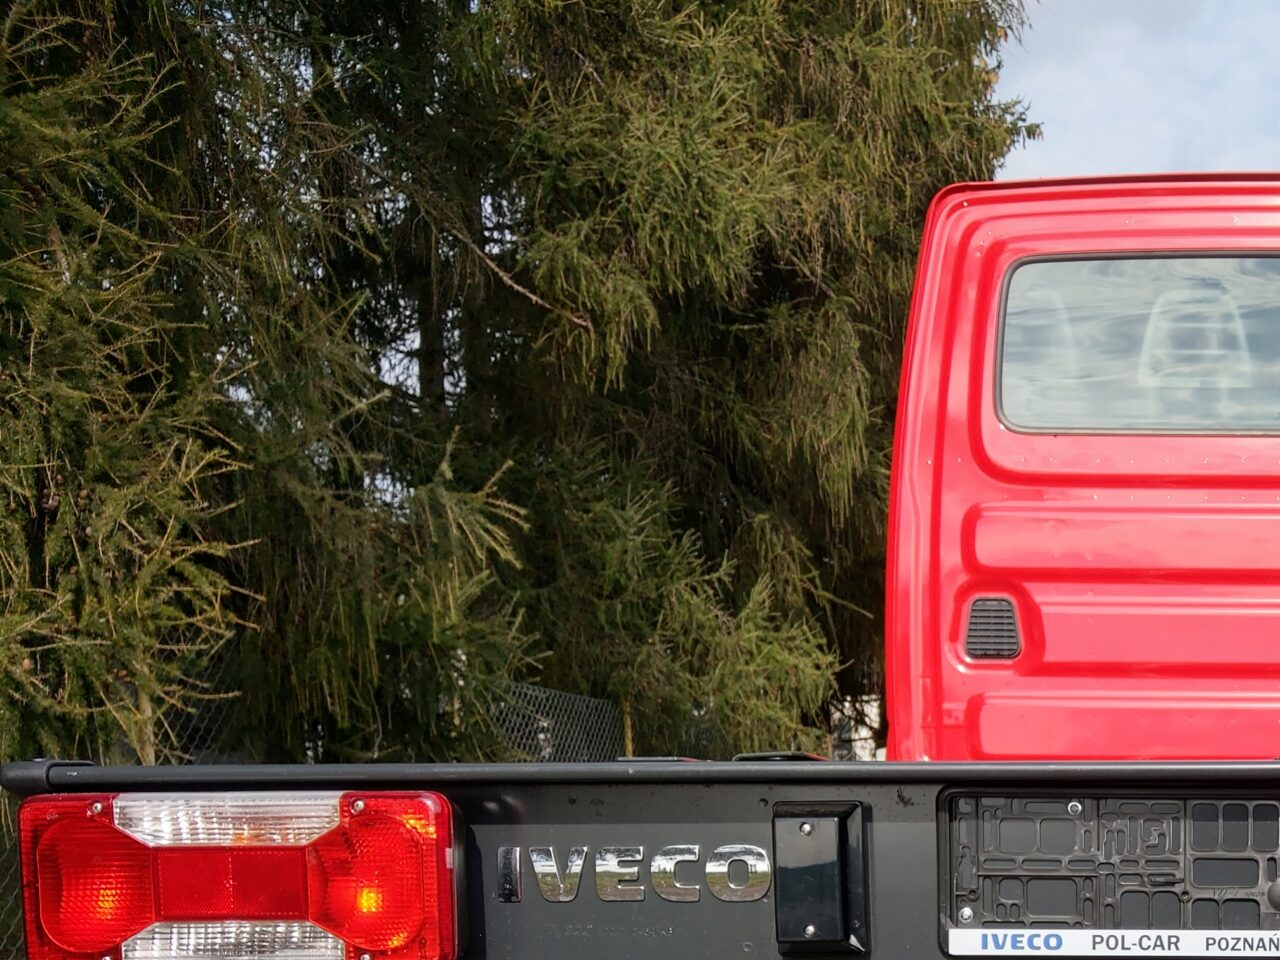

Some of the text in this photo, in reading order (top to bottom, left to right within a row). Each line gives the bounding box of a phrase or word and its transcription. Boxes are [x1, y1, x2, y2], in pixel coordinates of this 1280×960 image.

[497, 845, 772, 902] IVECO
[981, 933, 1063, 951] IVECO
[1091, 934, 1180, 951] POL-CAR
